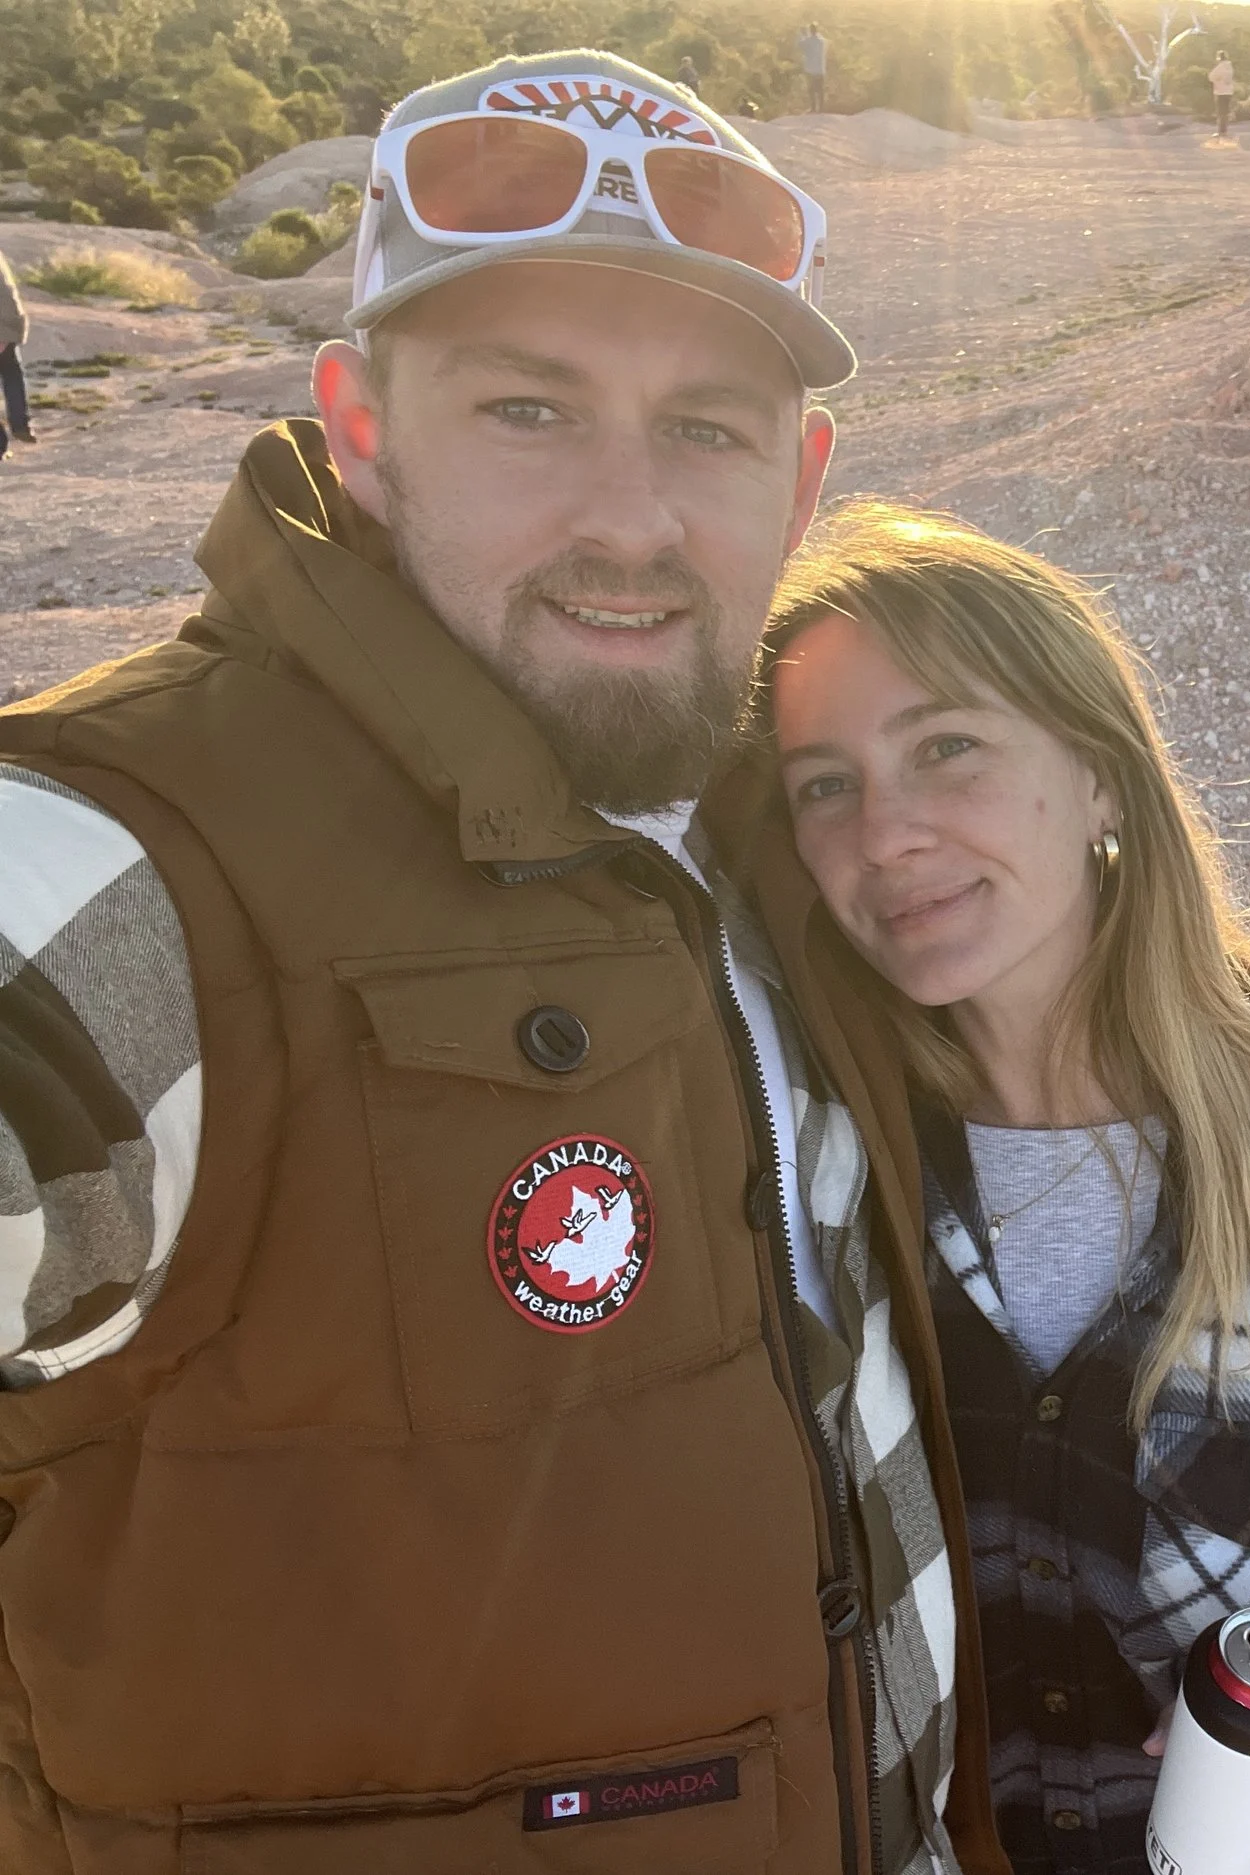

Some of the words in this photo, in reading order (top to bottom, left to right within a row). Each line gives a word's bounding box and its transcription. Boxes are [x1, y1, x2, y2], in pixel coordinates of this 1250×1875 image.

[593, 176, 639, 205] RE
[514, 1280, 605, 1324] weather
[610, 1250, 643, 1307] gear
